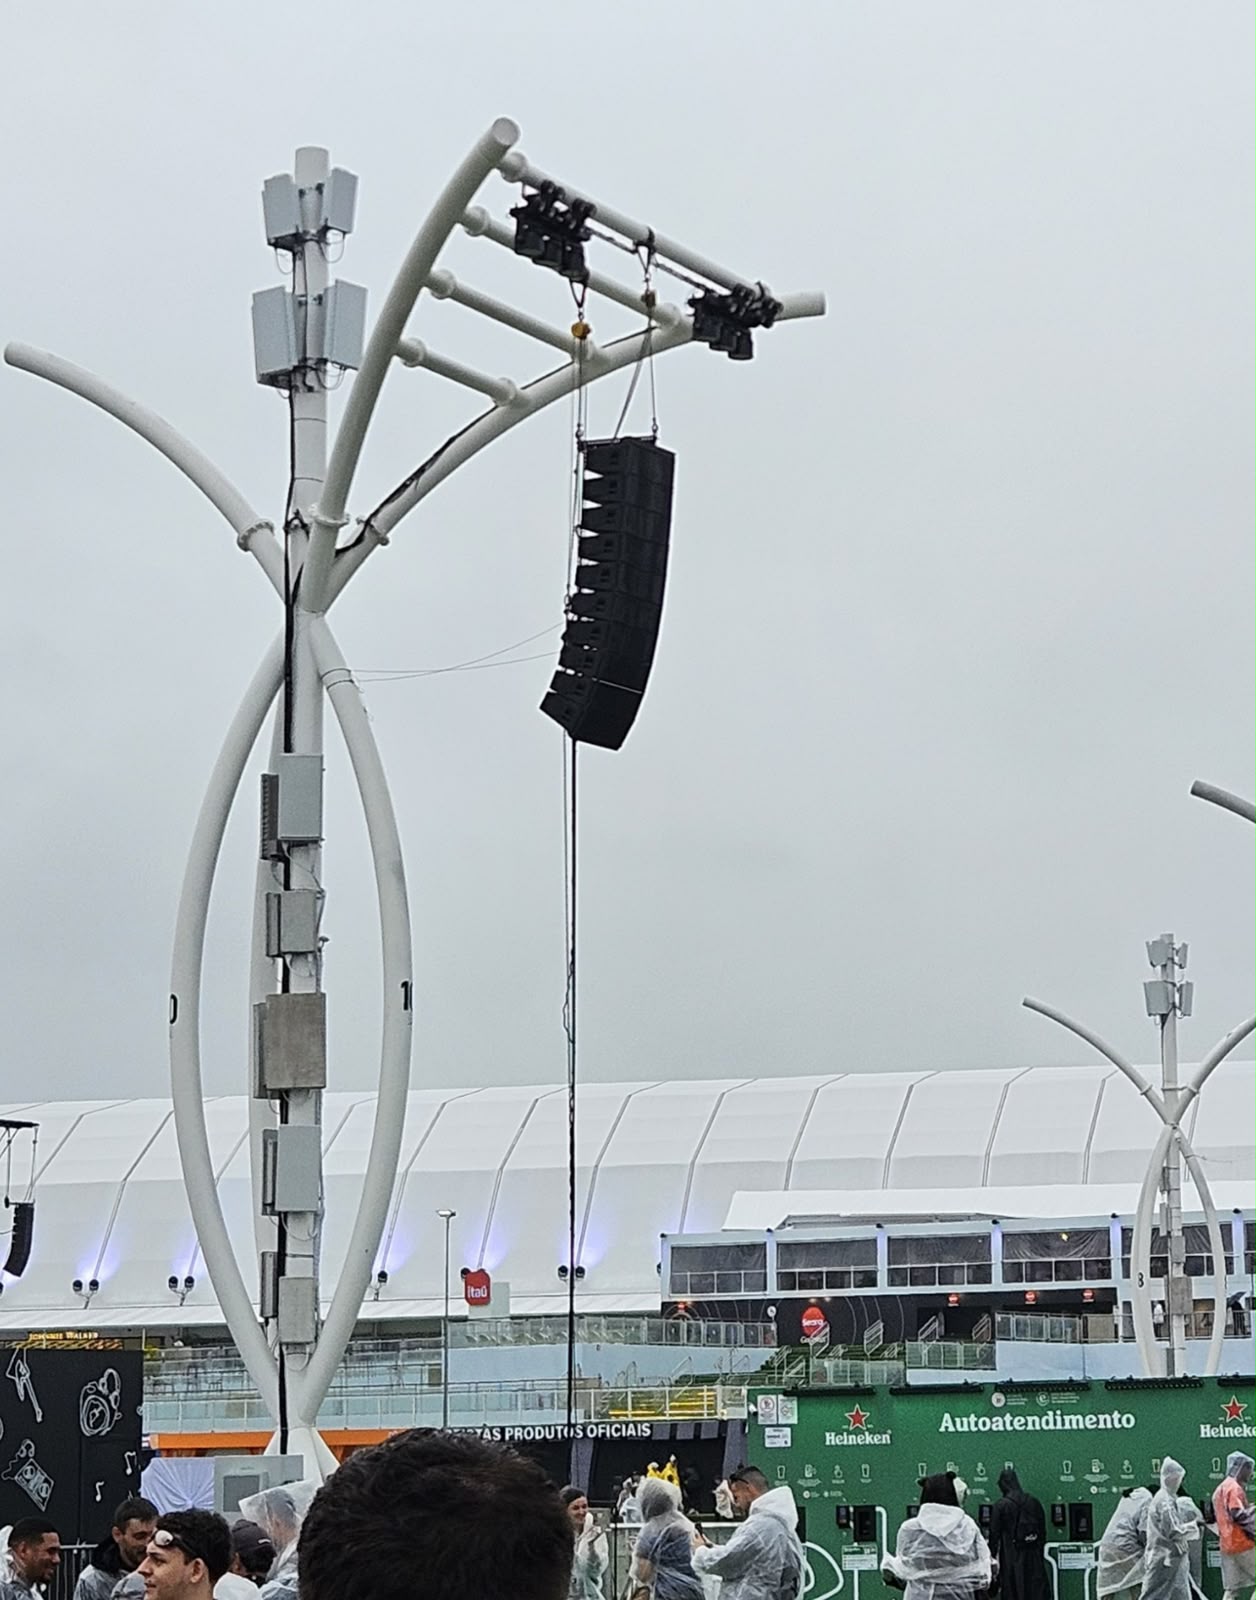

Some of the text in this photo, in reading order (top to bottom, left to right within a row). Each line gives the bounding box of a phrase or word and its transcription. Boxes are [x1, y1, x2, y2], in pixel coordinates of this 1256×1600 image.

[939, 1411, 1135, 1432] Autoatendimento
[504, 1425, 582, 1441] PRODUTOS
[586, 1422, 651, 1438] OFICIAIS
[825, 1431, 891, 1446] Heineken
